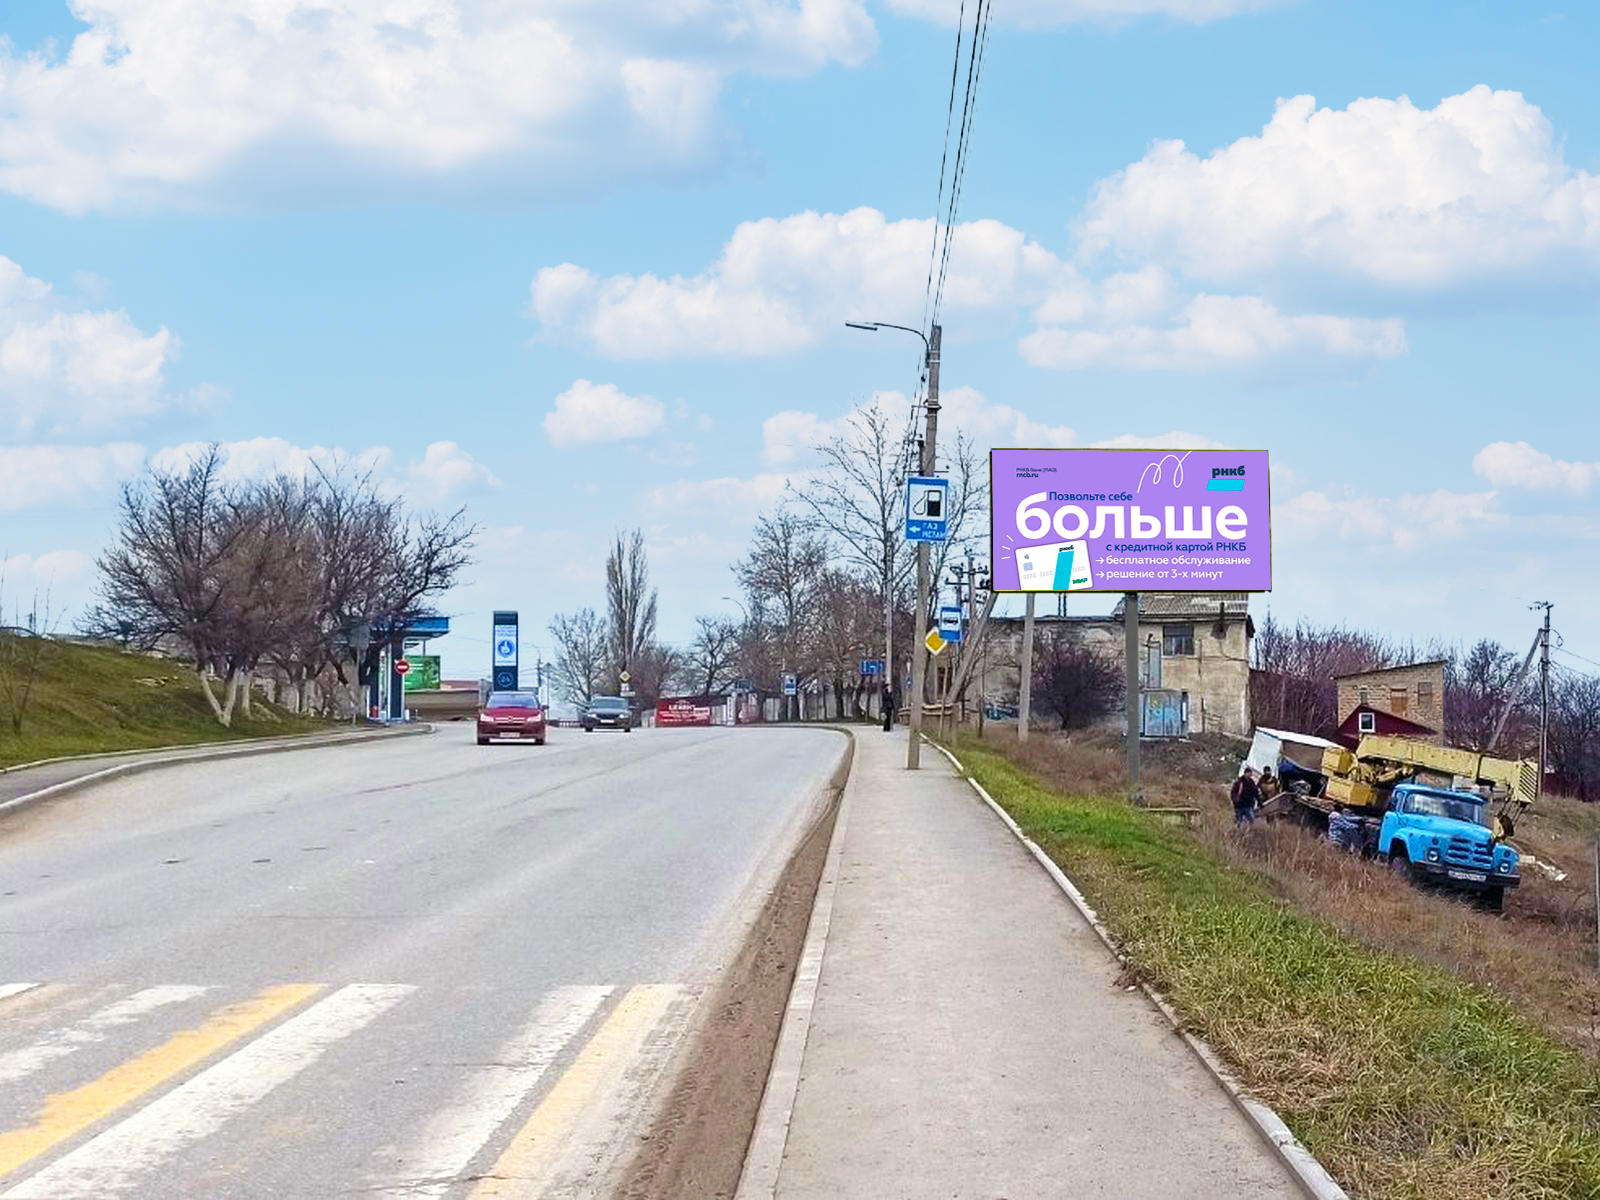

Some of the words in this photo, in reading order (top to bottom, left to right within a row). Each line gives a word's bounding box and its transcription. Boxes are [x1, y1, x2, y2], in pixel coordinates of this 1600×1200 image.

[1211, 465, 1246, 478] рнкб
[1049, 491, 1106, 501] Позвольте
[1108, 491, 1133, 501] себе
[1015, 491, 1248, 540] больше
[1114, 542, 1174, 553] кредитной
[1176, 542, 1214, 553] картой
[1216, 542, 1247, 551] РНКБ
[1106, 555, 1169, 565] бесплатное
[1171, 555, 1251, 567] обслуживание
[1106, 571, 1155, 580] решение
[1171, 569, 1188, 578] 3-х
[1190, 571, 1224, 580] минут
